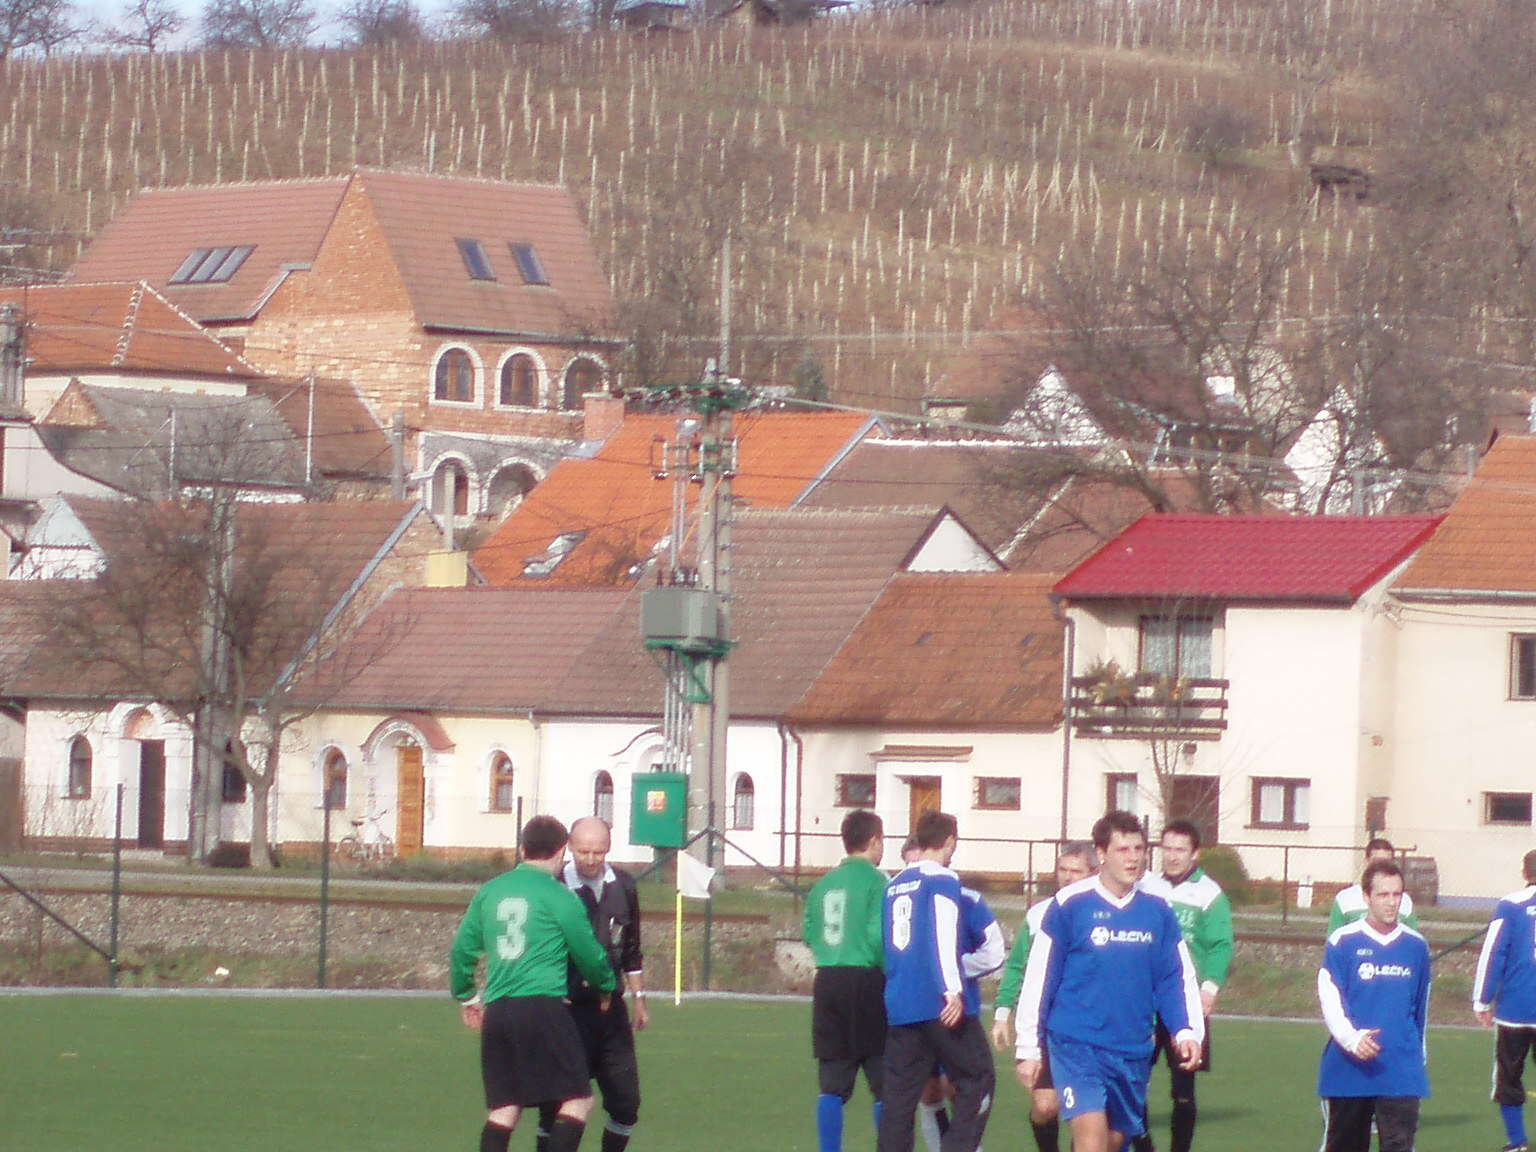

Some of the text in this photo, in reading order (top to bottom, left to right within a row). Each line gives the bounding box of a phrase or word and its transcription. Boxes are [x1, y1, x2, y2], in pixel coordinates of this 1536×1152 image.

[497, 897, 529, 961] 3
[823, 889, 846, 946] 9
[1063, 1086, 1075, 1109] 3
